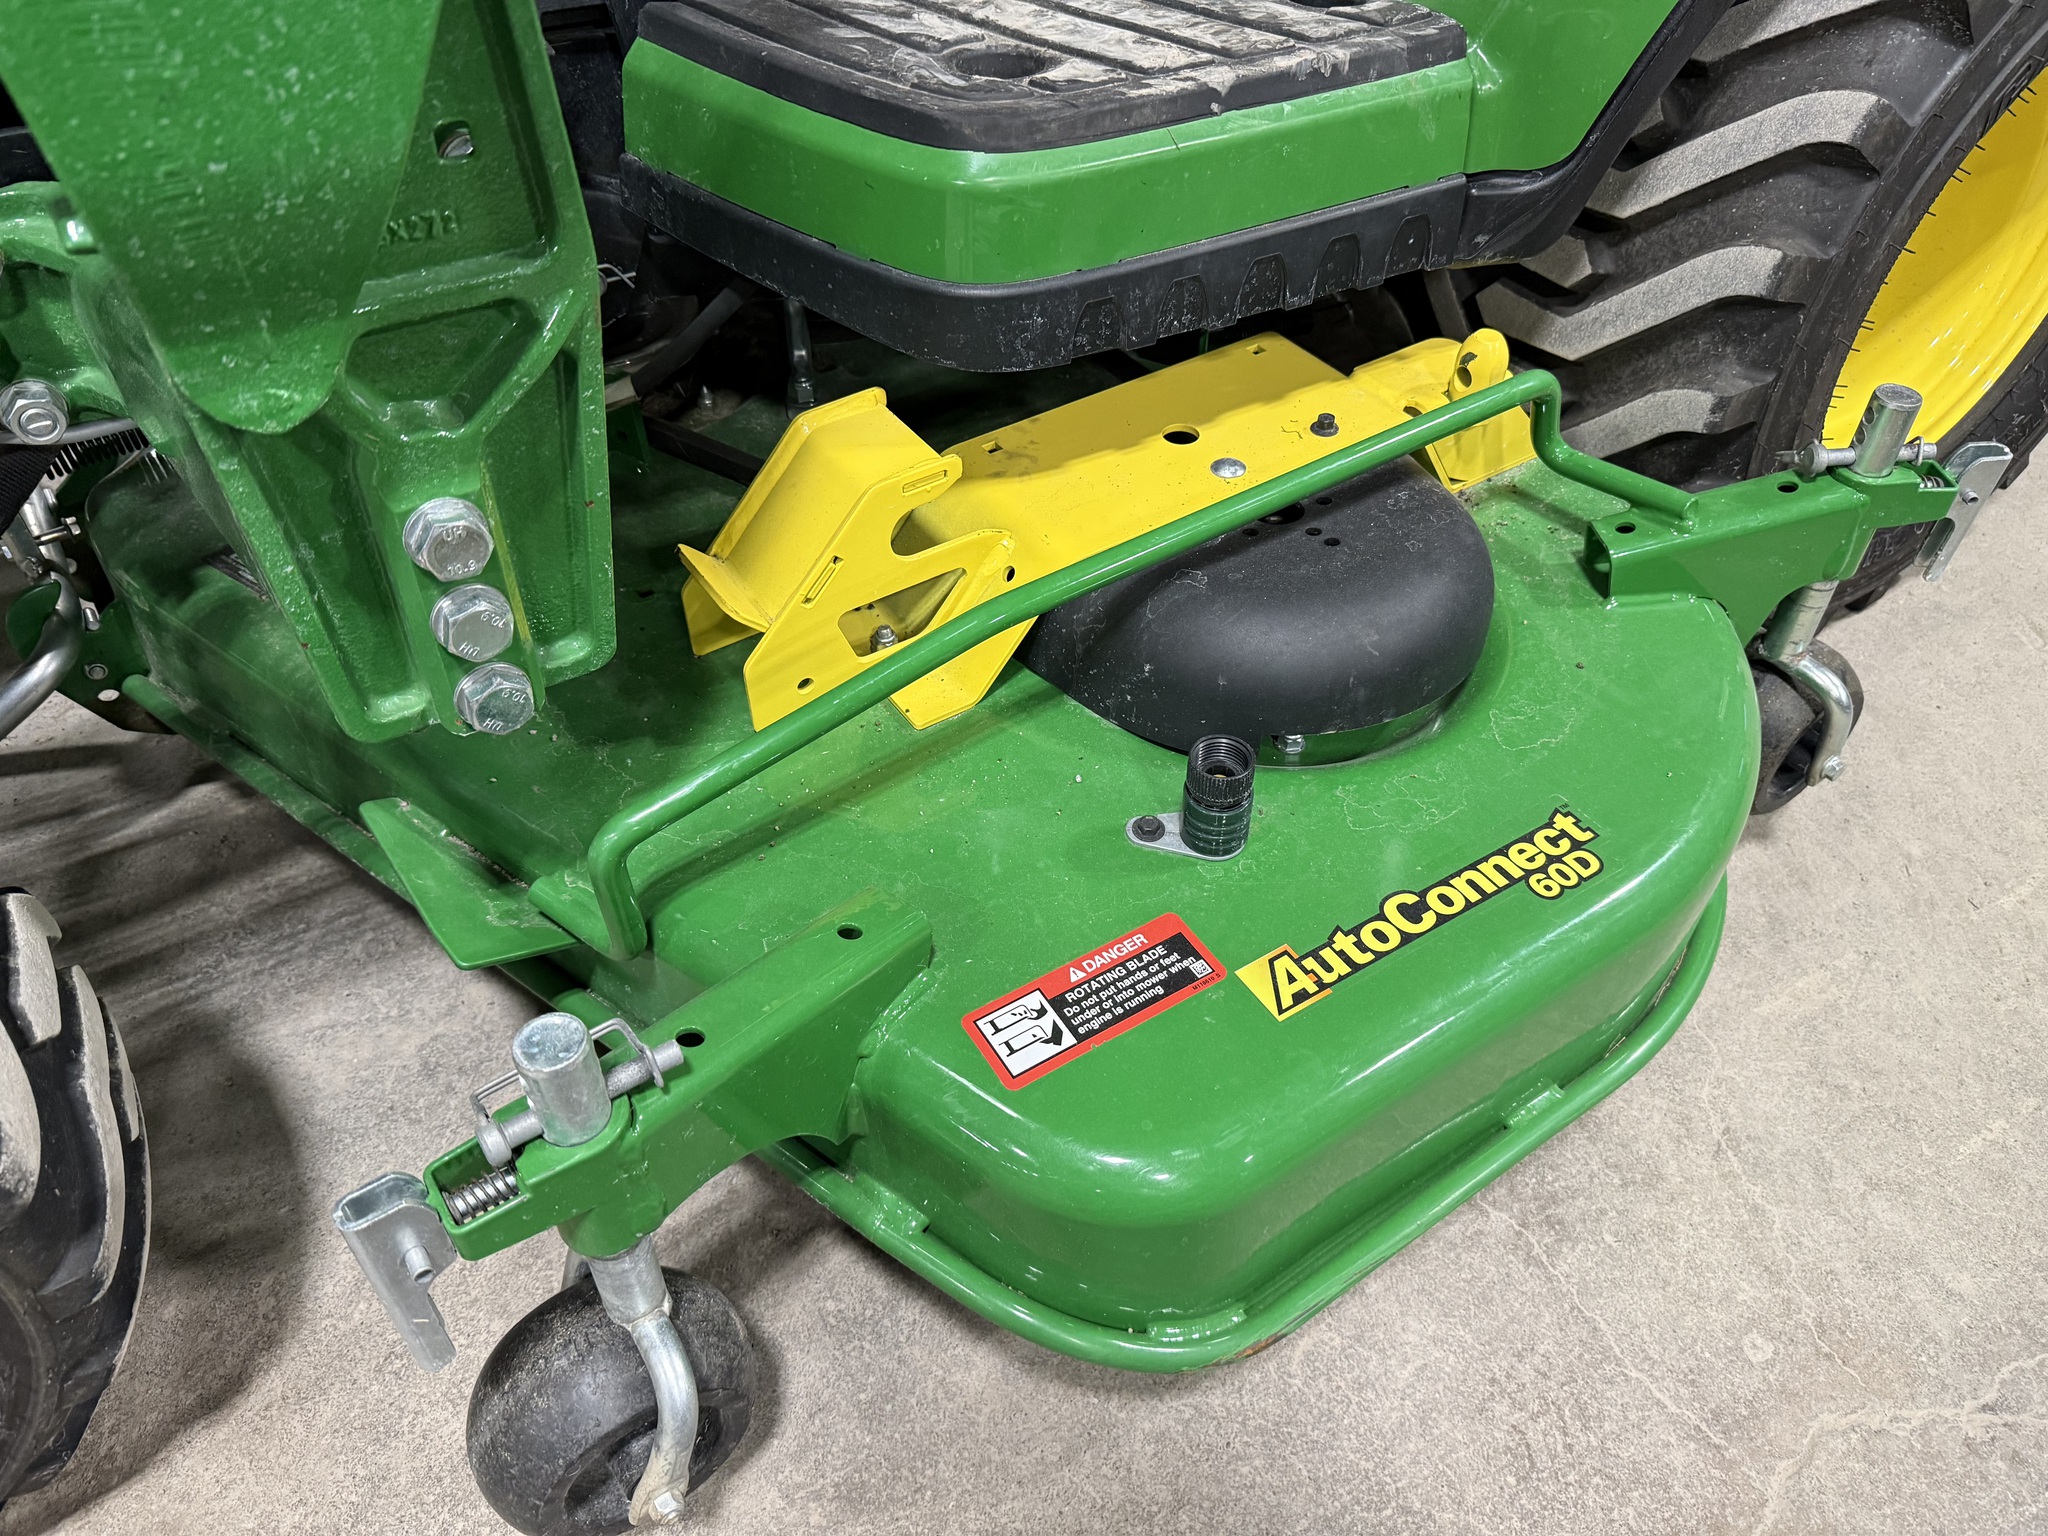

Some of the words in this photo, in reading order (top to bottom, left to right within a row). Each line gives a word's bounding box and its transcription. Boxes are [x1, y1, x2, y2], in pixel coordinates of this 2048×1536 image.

[480, 611, 506, 629] 10.9
[501, 688, 526, 703] 10.9
[483, 717, 502, 731] UH
[1529, 849, 1601, 898] 60D
[1272, 812, 1593, 1010] AutoConnect
[1065, 966, 1126, 1003] ROTATING
[1126, 945, 1167, 971] BLADE
[1082, 934, 1148, 972] DANGER
[1064, 1005, 1079, 1017] Do
[1082, 995, 1100, 1008] not
[1100, 984, 1118, 1001] put
[1116, 969, 1148, 990] hands
[1149, 964, 1160, 972] or
[1160, 952, 1181, 966] feet
[1071, 1005, 1100, 1025] under
[1102, 998, 1113, 1009] or
[1115, 989, 1135, 1003] into
[1135, 972, 1169, 992] mower
[1167, 957, 1197, 973] when
[1078, 1013, 1112, 1034] engine
[1113, 1006, 1123, 1016] is
[1124, 985, 1164, 1010] running
